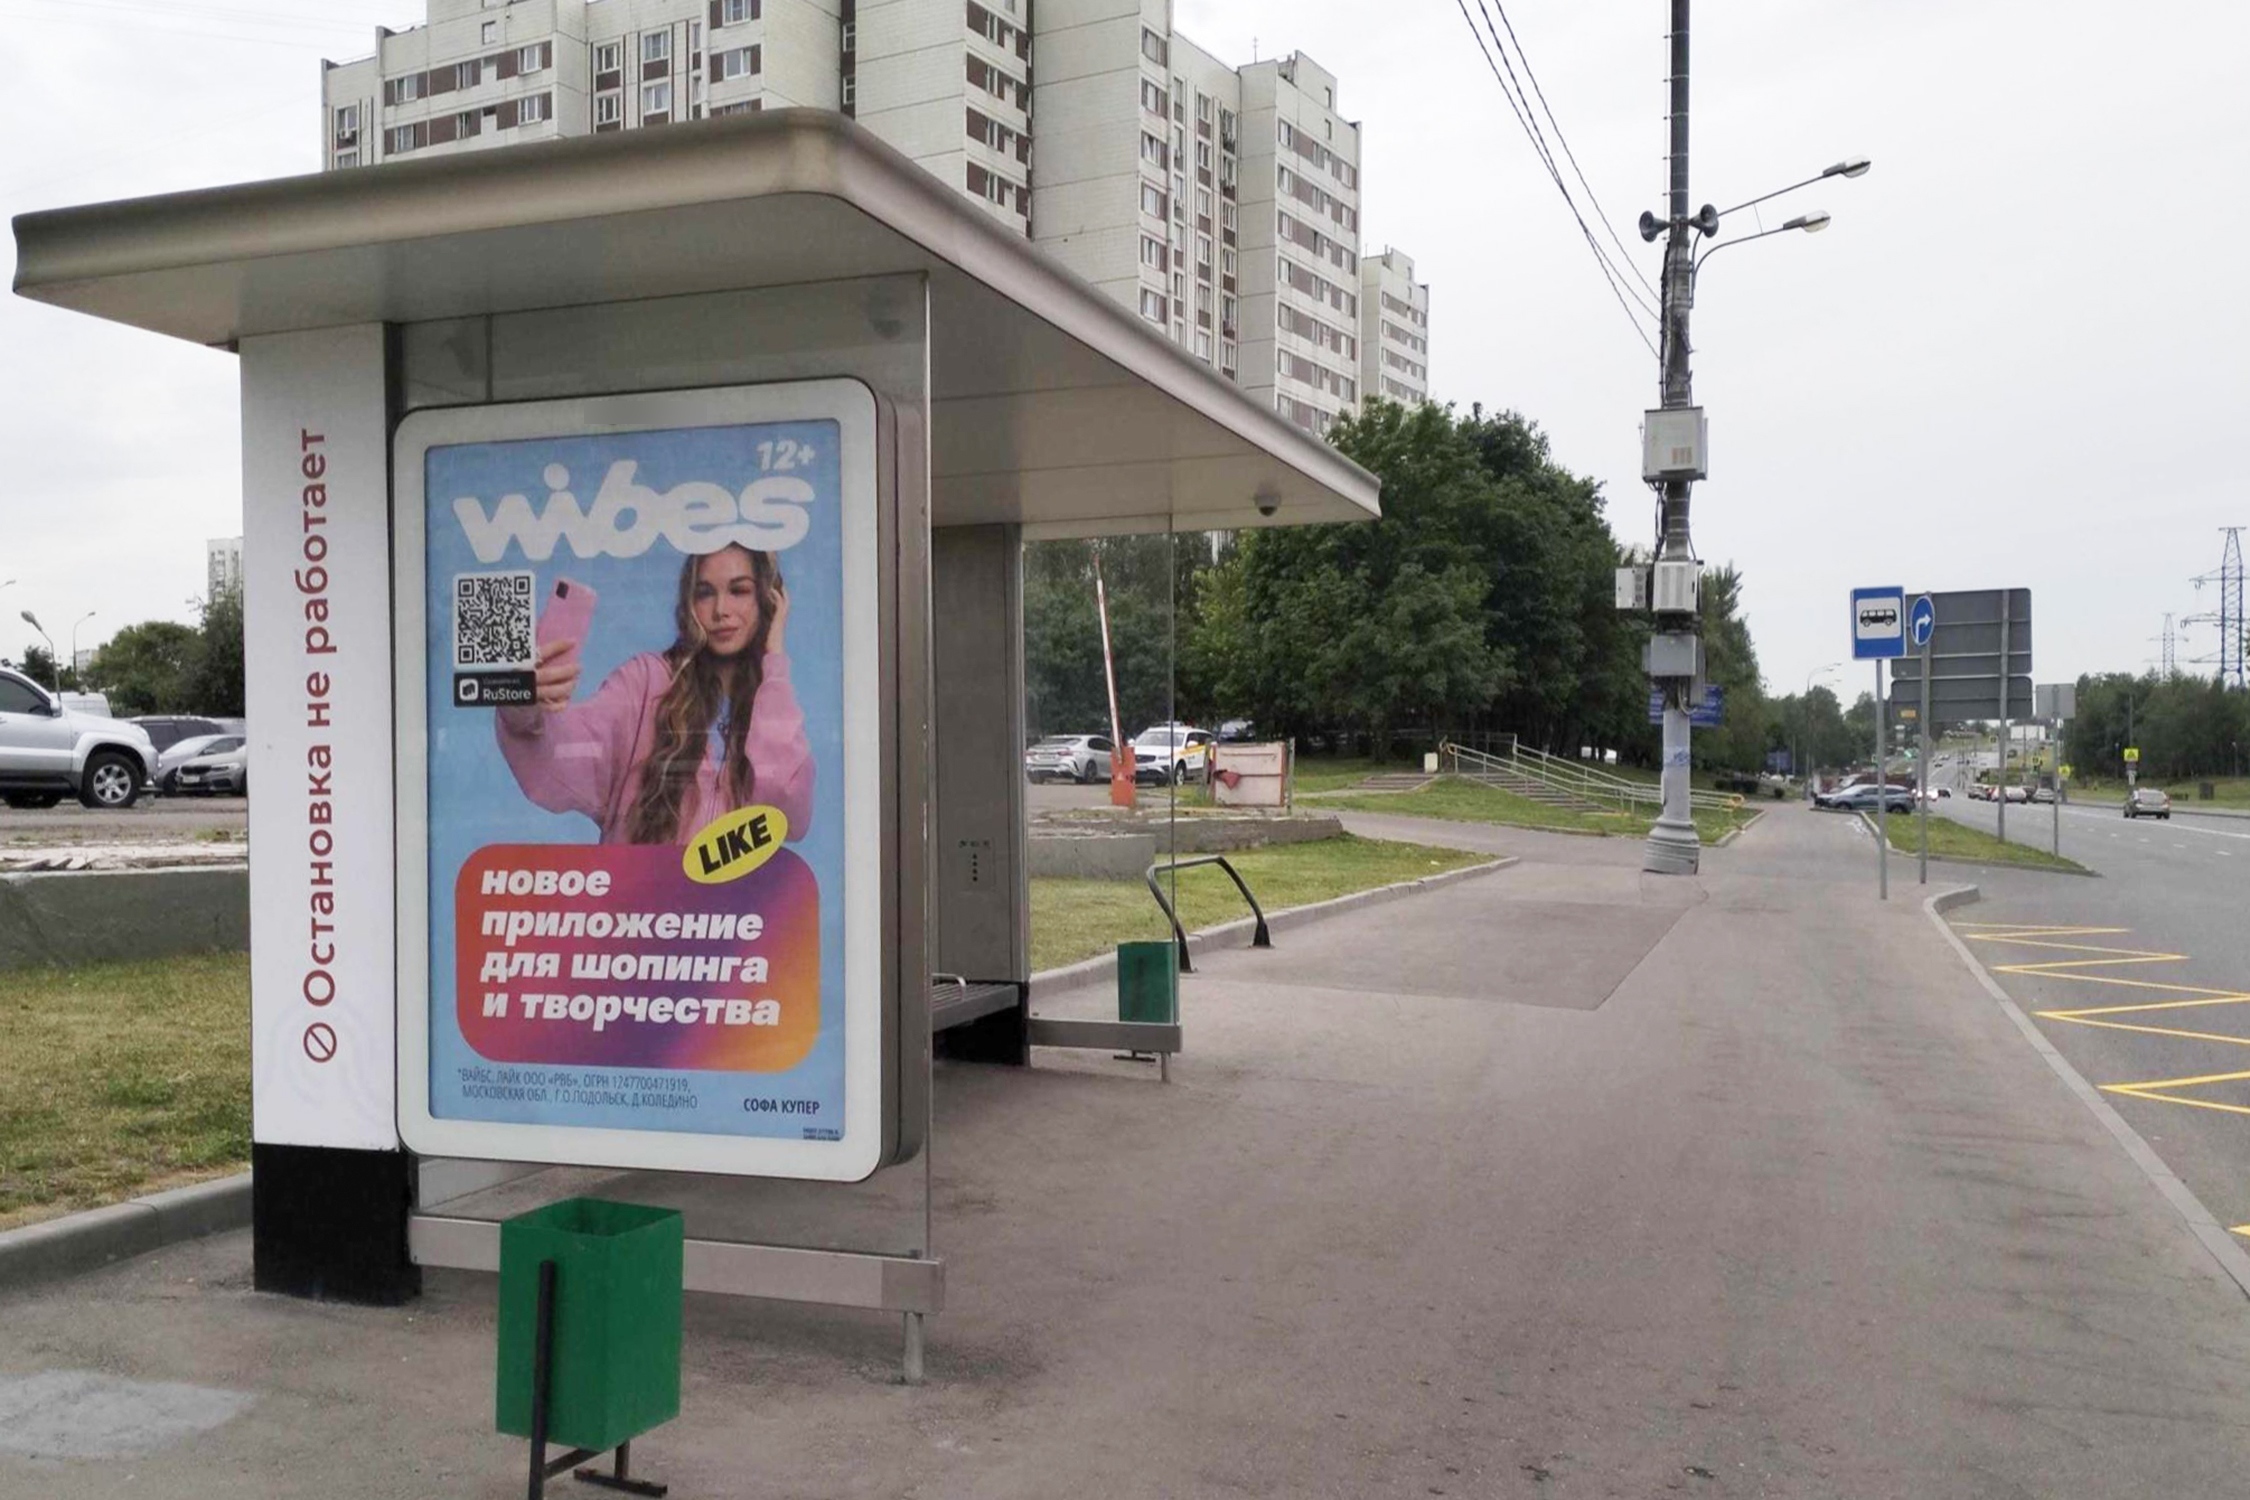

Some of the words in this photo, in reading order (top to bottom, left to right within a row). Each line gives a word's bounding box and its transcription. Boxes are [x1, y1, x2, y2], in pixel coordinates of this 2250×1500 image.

[757, 440, 815, 471] 12+
[453, 460, 815, 563] wibes
[294, 428, 337, 654] работает
[306, 671, 332, 727] не
[483, 687, 532, 700] RuStore
[698, 814, 772, 876] LIKE
[302, 745, 336, 1007] Остановка
[481, 870, 611, 897] новое
[481, 911, 763, 947] приложение
[480, 952, 560, 983] для
[571, 954, 769, 983] шопинга
[482, 993, 509, 1018] и
[520, 993, 781, 1032] творчества
[523, 1071, 546, 1086] ООО
[583, 1074, 609, 1088] ОГРН
[743, 1098, 778, 1113] СОФА
[781, 1099, 820, 1115] КУПЕР
